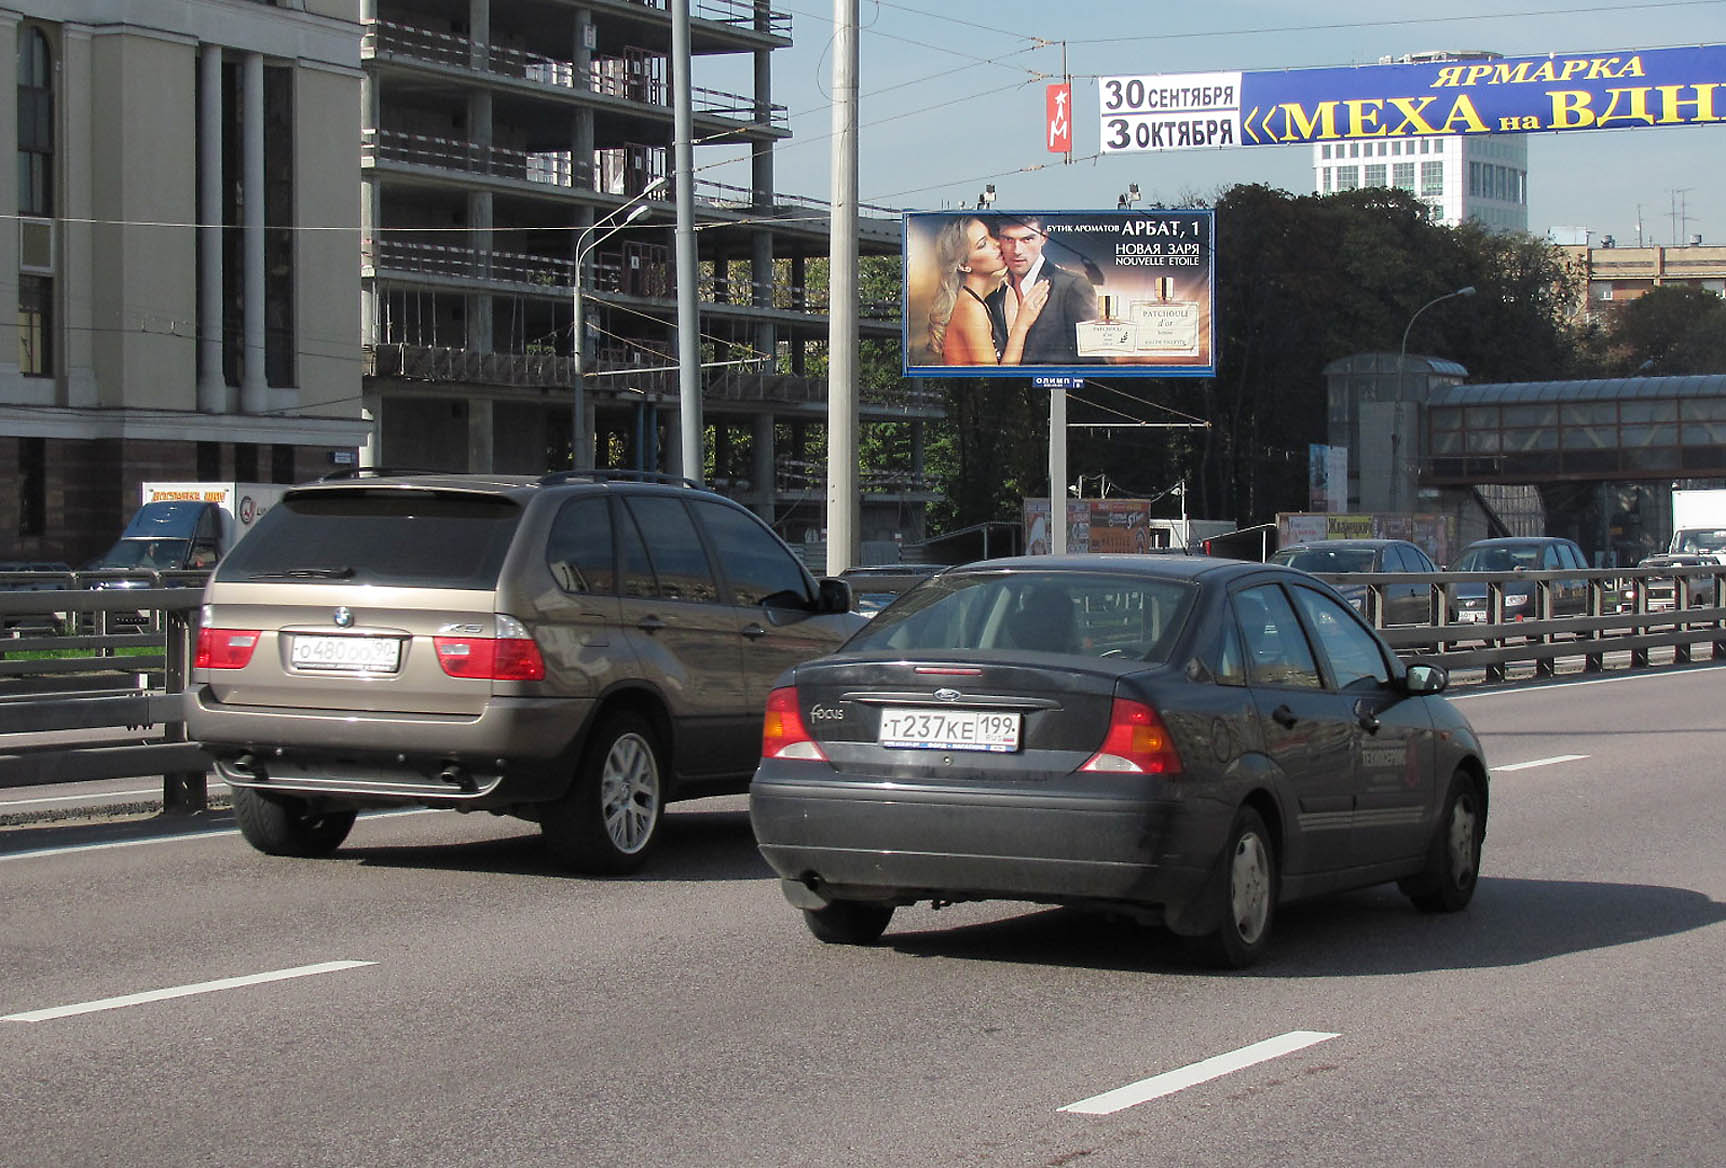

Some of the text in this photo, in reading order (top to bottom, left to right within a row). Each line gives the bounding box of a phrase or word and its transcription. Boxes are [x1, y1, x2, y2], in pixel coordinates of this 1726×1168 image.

[1430, 55, 1646, 88] ЯРМАРКА
[1105, 79, 1234, 110] 30 СЕНТЯБРЯ
[1498, 113, 1541, 131] на
[1545, 82, 1726, 130] ВДН
[1106, 118, 1233, 149] 3 ОКТЯБРЯ
[1047, 220, 1199, 239] БУТИК АРОМАТОВ АРБАТ, 1
[1115, 243, 1200, 255] НОВАЯ ЗАРЯ
[1115, 256, 1165, 266] NOUVELLE
[1143, 310, 1189, 318] PATCHOULI
